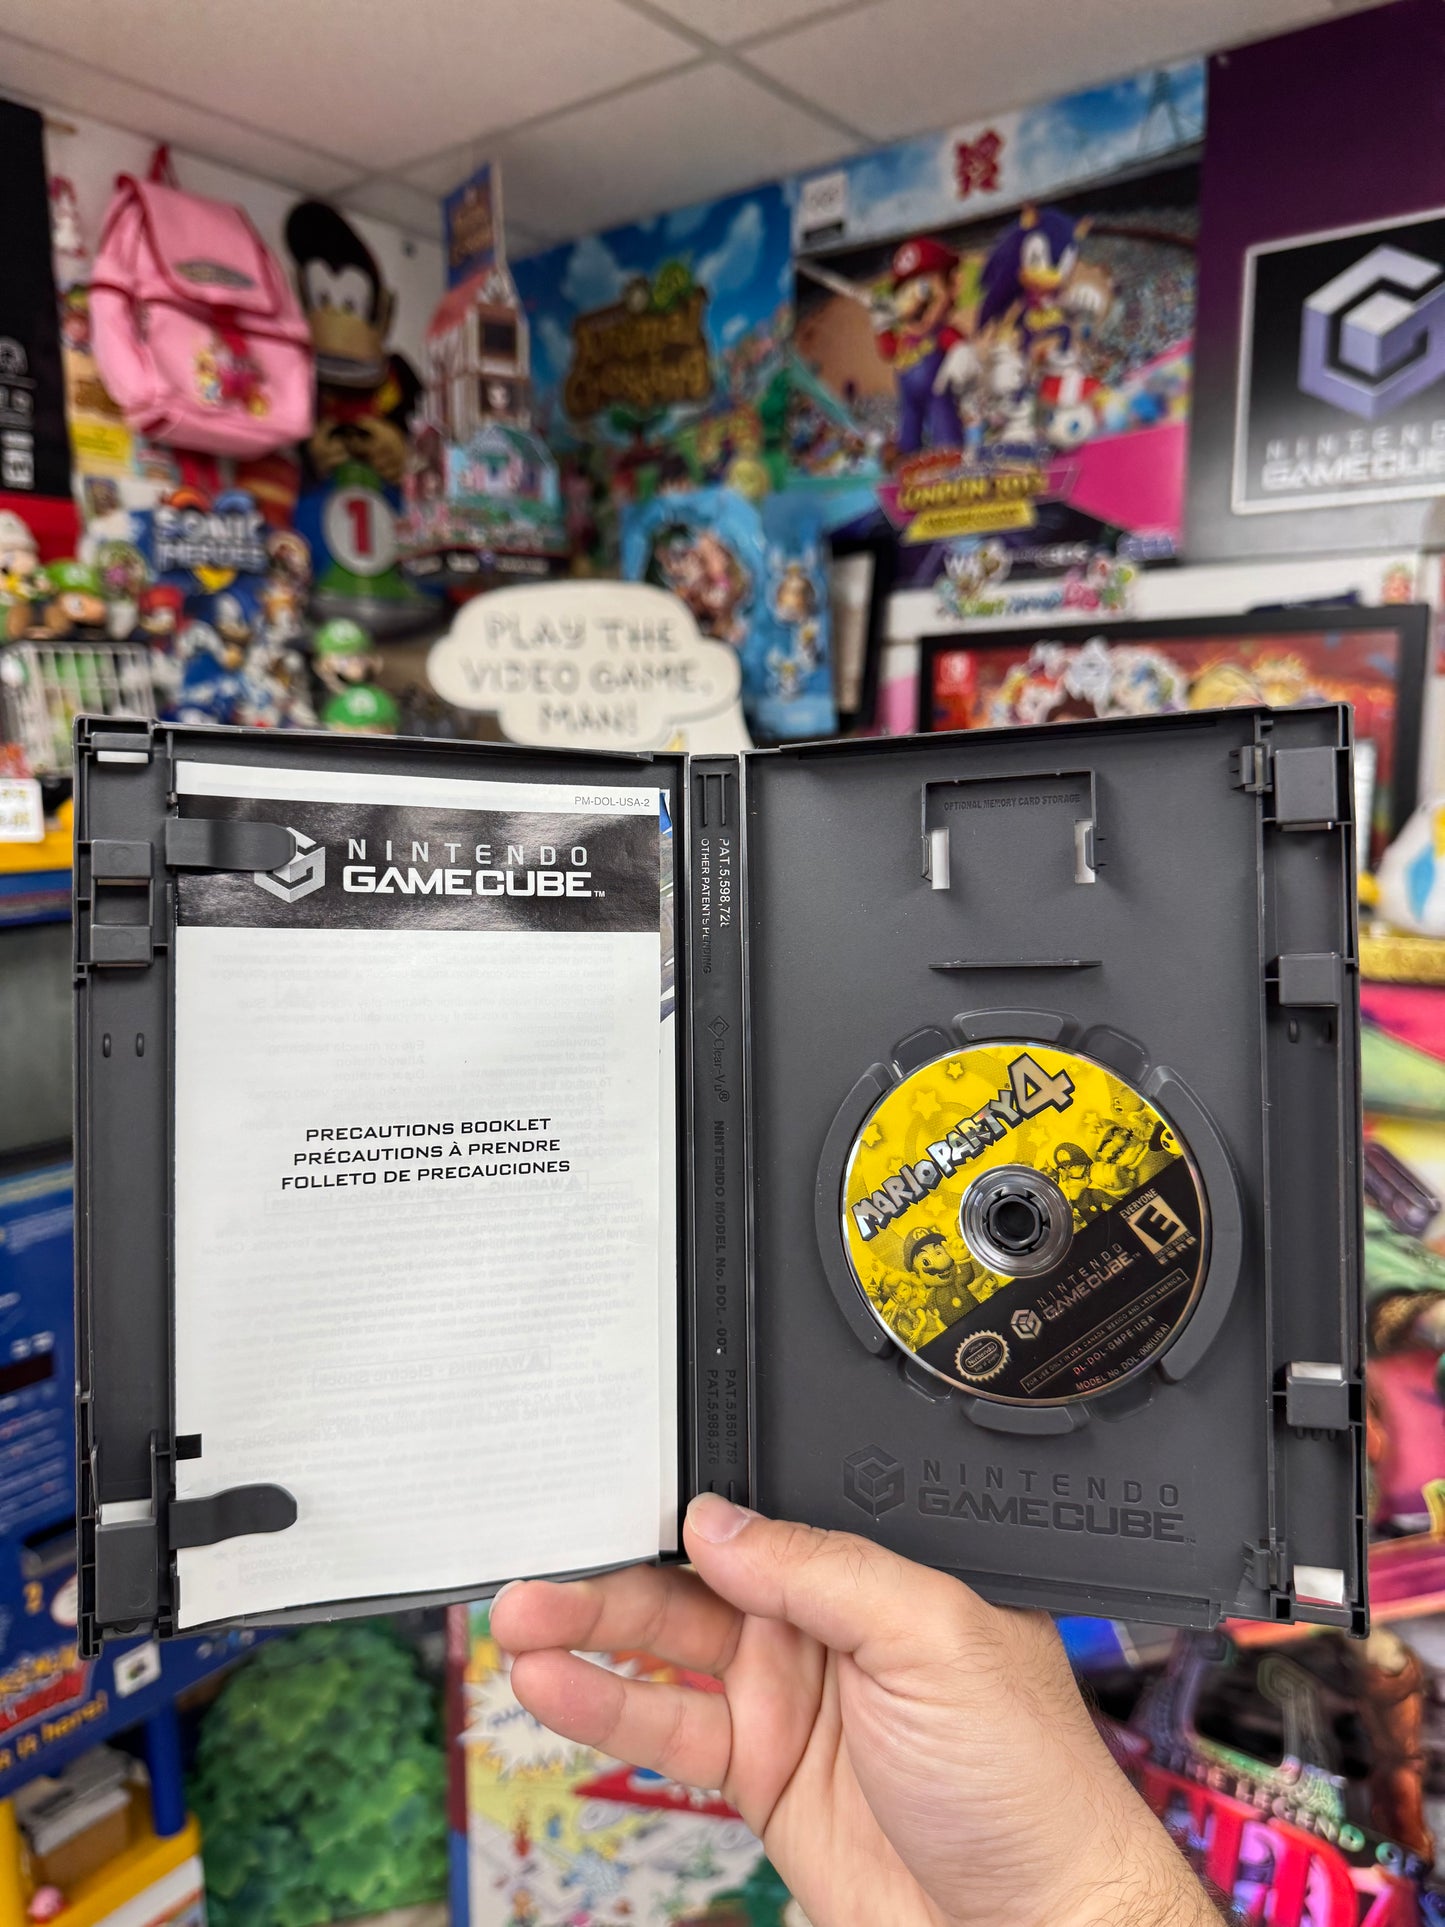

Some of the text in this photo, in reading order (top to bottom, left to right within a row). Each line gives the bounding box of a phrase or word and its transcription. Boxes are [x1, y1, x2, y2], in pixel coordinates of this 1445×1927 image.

[485, 612, 681, 651] PLAY THE
[461, 656, 581, 694] VIDEO
[574, 795, 650, 808] PM-DOL-USA-2
[944, 793, 1081, 811] OPTIONAL MEMORY CARD STORAGE
[348, 838, 588, 866] NINTENDO
[701, 838, 712, 974] OTHER PATENTS PENDING
[306, 1118, 551, 1142] PRECAUTIONS BOOKLET
[851, 1052, 1075, 1242] MARIO PARTY 4
[294, 1139, 560, 1165] PRÉCAUTIONS À PRENDRE
[714, 1120, 725, 1198] NINTENDO
[282, 1160, 571, 1190] FOLLETO DE PRECAUCIONES
[1119, 1187, 1158, 1219] EVERYONE
[715, 1201, 726, 1253] MODEL
[1036, 1243, 1123, 1308] NINTENDO
[715, 1285, 727, 1316] DOL
[1083, 1330, 1105, 1348] CANADA
[1105, 1313, 1128, 1330] MEXICO
[1128, 1305, 1140, 1317] AND
[1140, 1294, 1157, 1308] LATIN
[1157, 1275, 1182, 1295] AMERICA
[1075, 1374, 1109, 1391] MODEL
[923, 1459, 1179, 1508] NINTENDO
